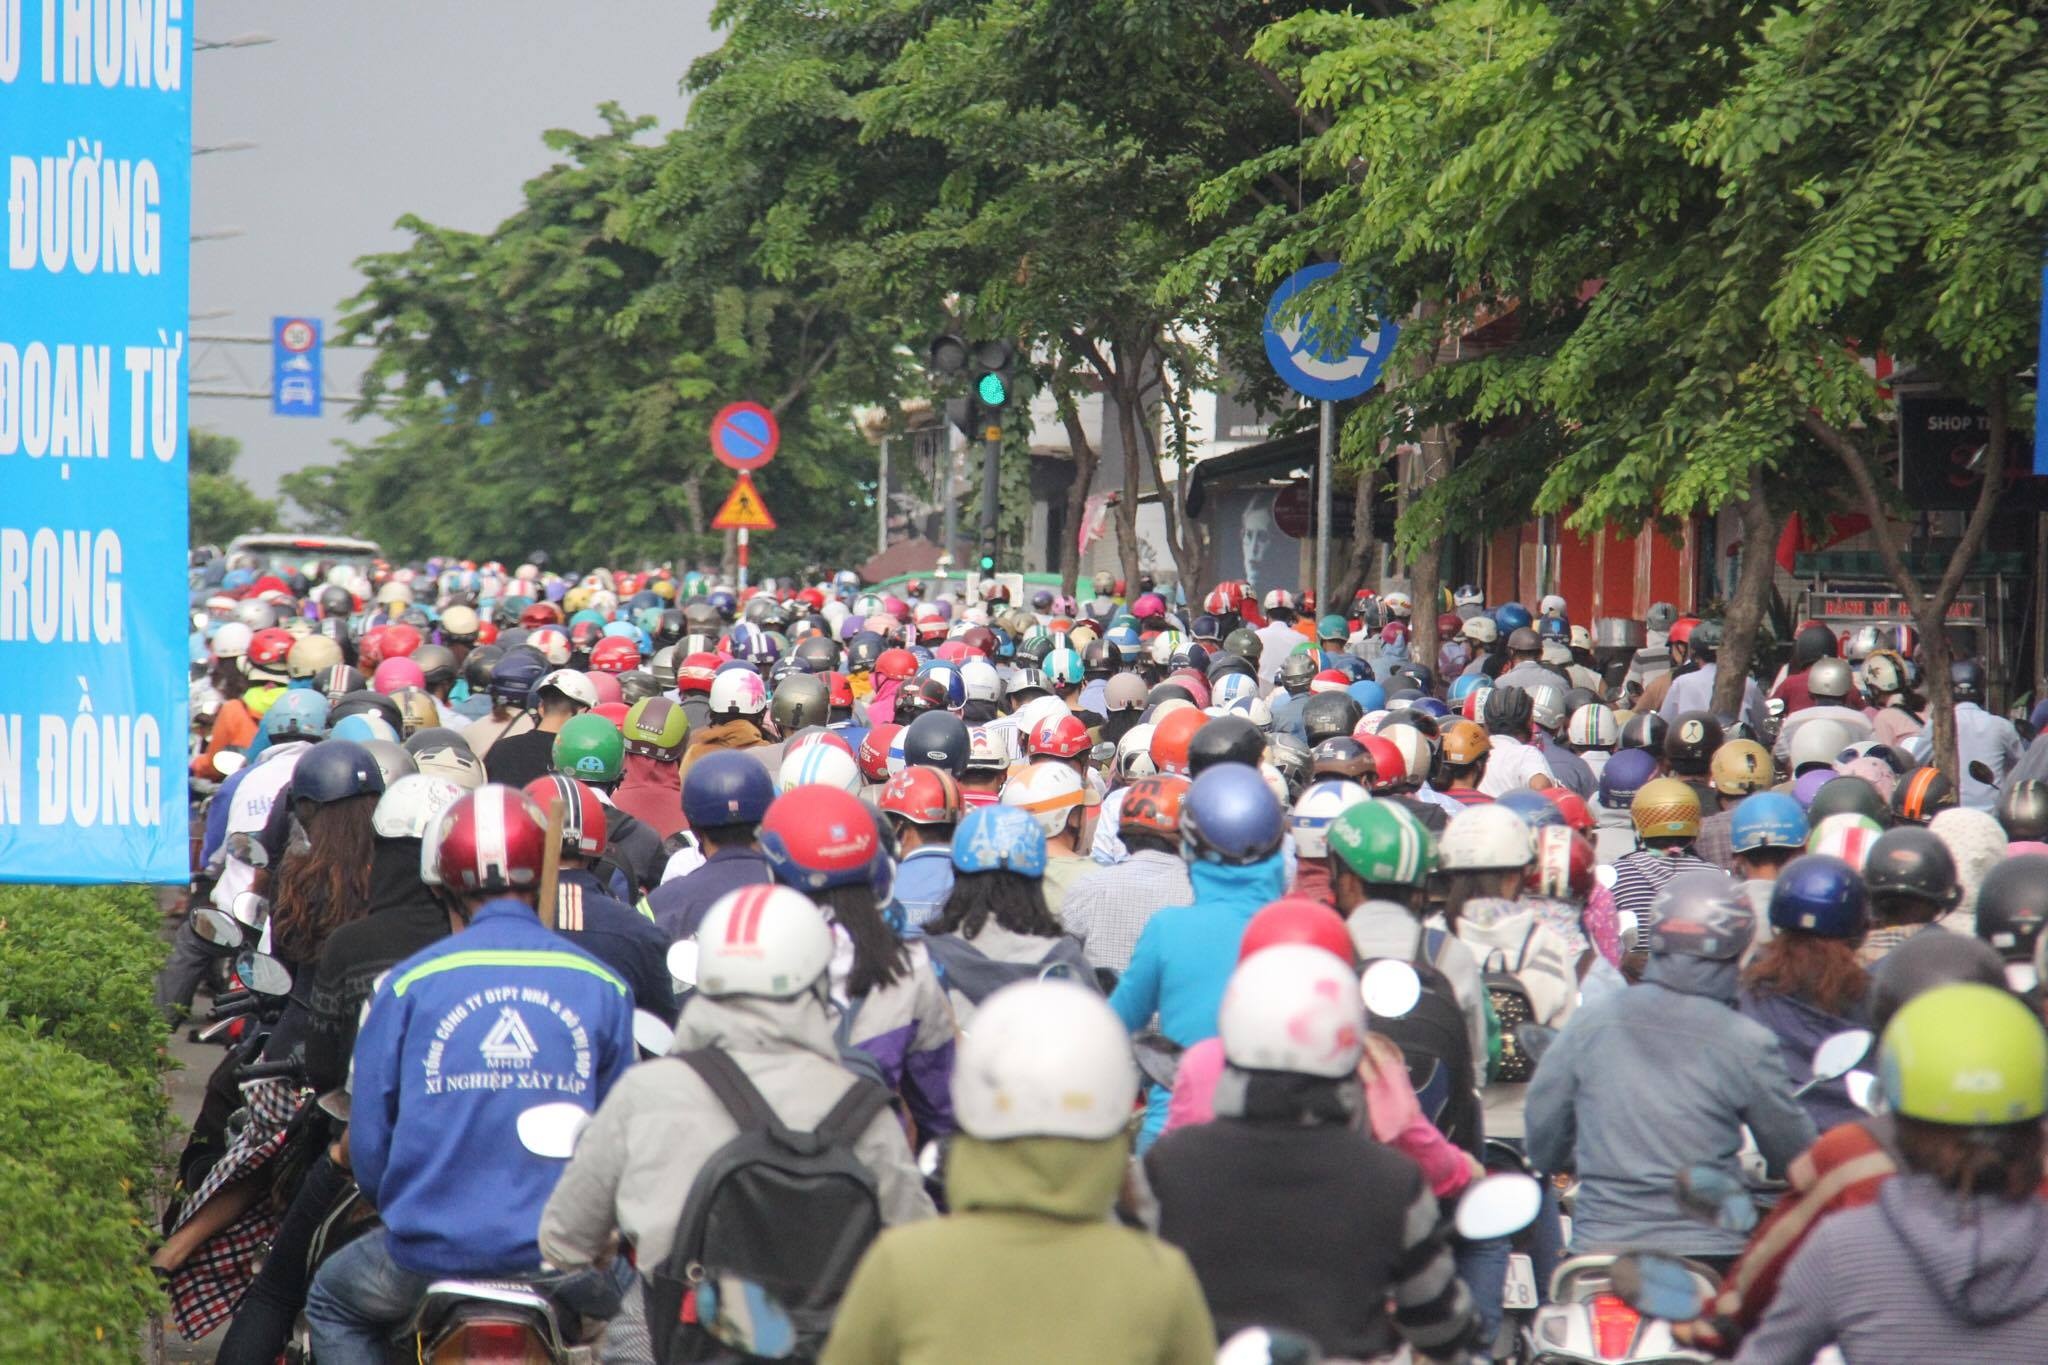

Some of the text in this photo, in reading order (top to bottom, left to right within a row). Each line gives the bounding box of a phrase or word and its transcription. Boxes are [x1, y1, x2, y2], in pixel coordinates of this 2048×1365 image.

[8, 136, 161, 276] ĐƯỜNG
[0, 328, 183, 480] ĐOẠN TỪ
[1927, 416, 1992, 430] SHOP T
[1, 527, 123, 645] RONG
[36, 675, 161, 828] ĐỒNG
[465, 992, 484, 1012] TY
[446, 1070, 514, 1092] NGHIỆP
[517, 1069, 553, 1089] XÂY
